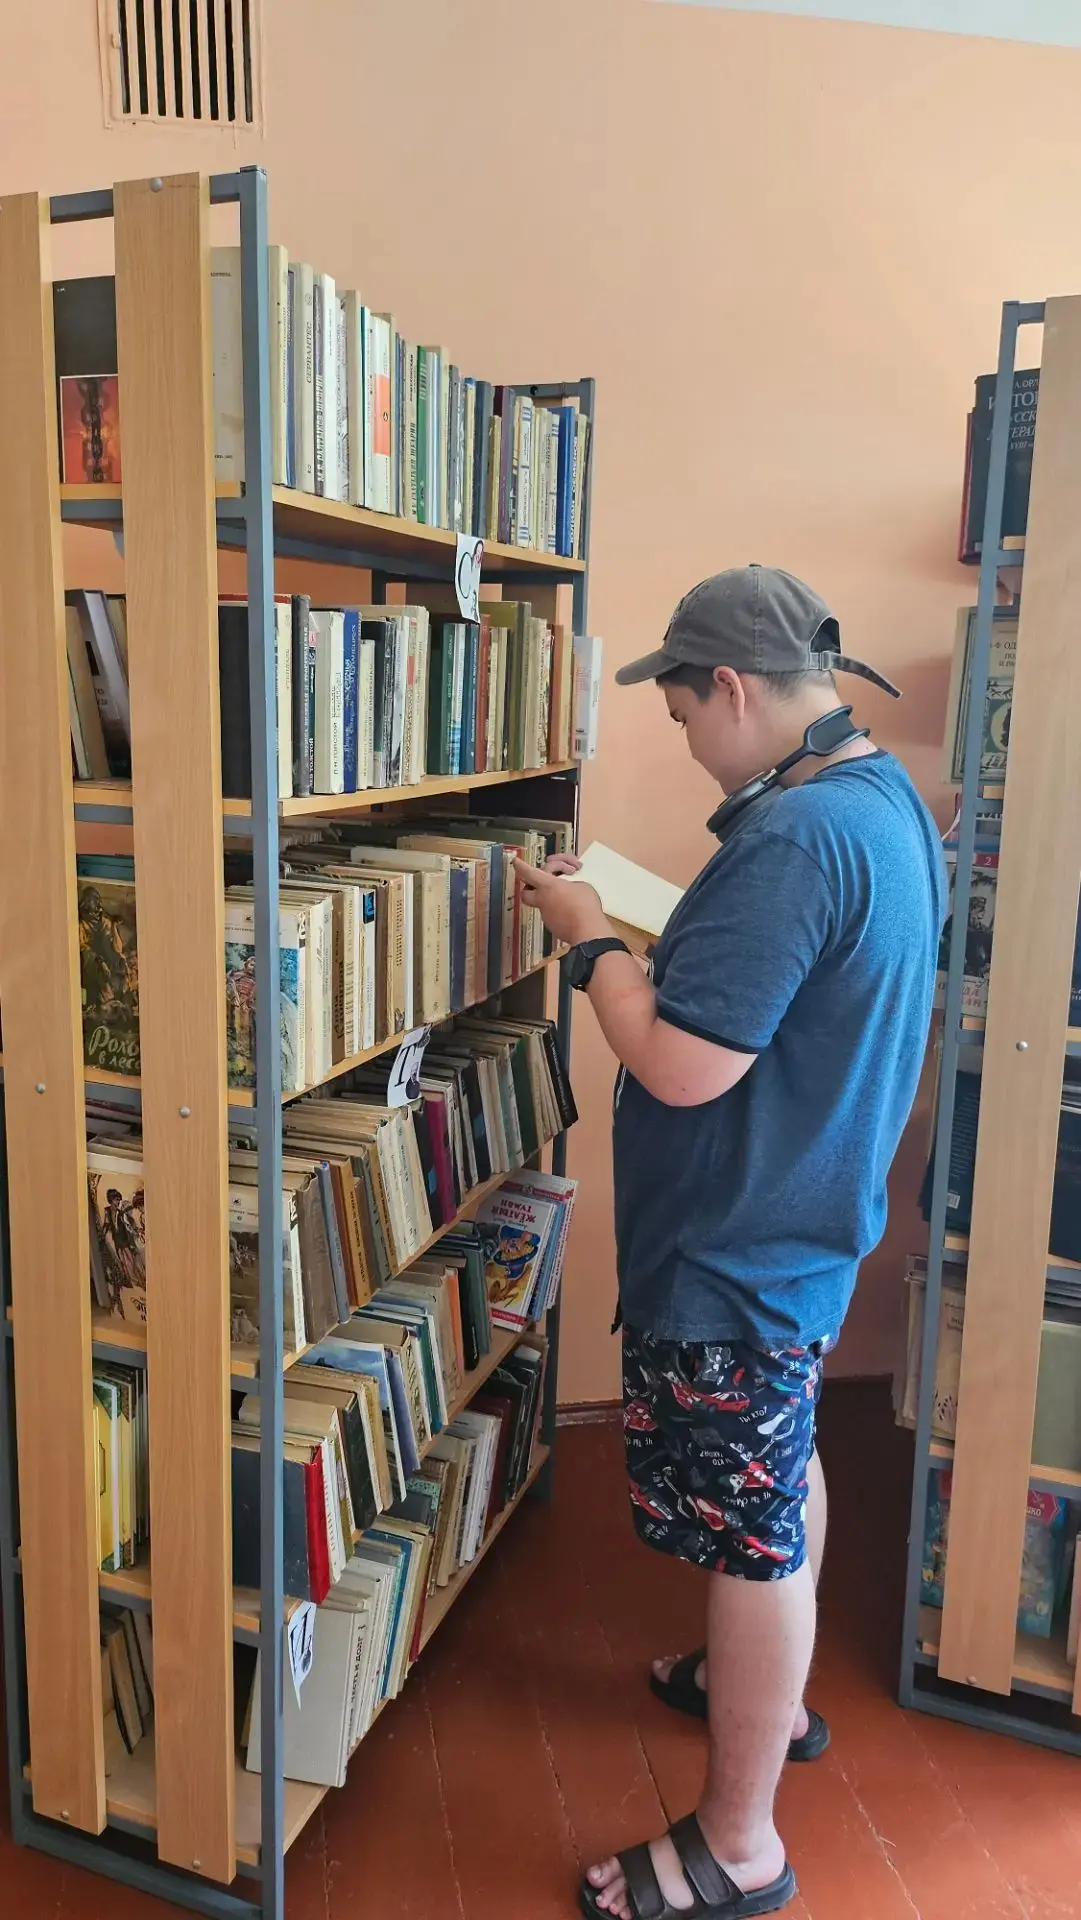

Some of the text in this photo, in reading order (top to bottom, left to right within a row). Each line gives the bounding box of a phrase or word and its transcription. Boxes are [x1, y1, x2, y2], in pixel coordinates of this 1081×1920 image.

[984, 856, 992, 866] 2
[89, 1025, 140, 1056] Роль
[491, 1206, 536, 1224] ЖЁЛТЫЙ
[500, 1199, 532, 1213] ТУМАН
[355, 1636, 364, 1662] ДОЛГ
